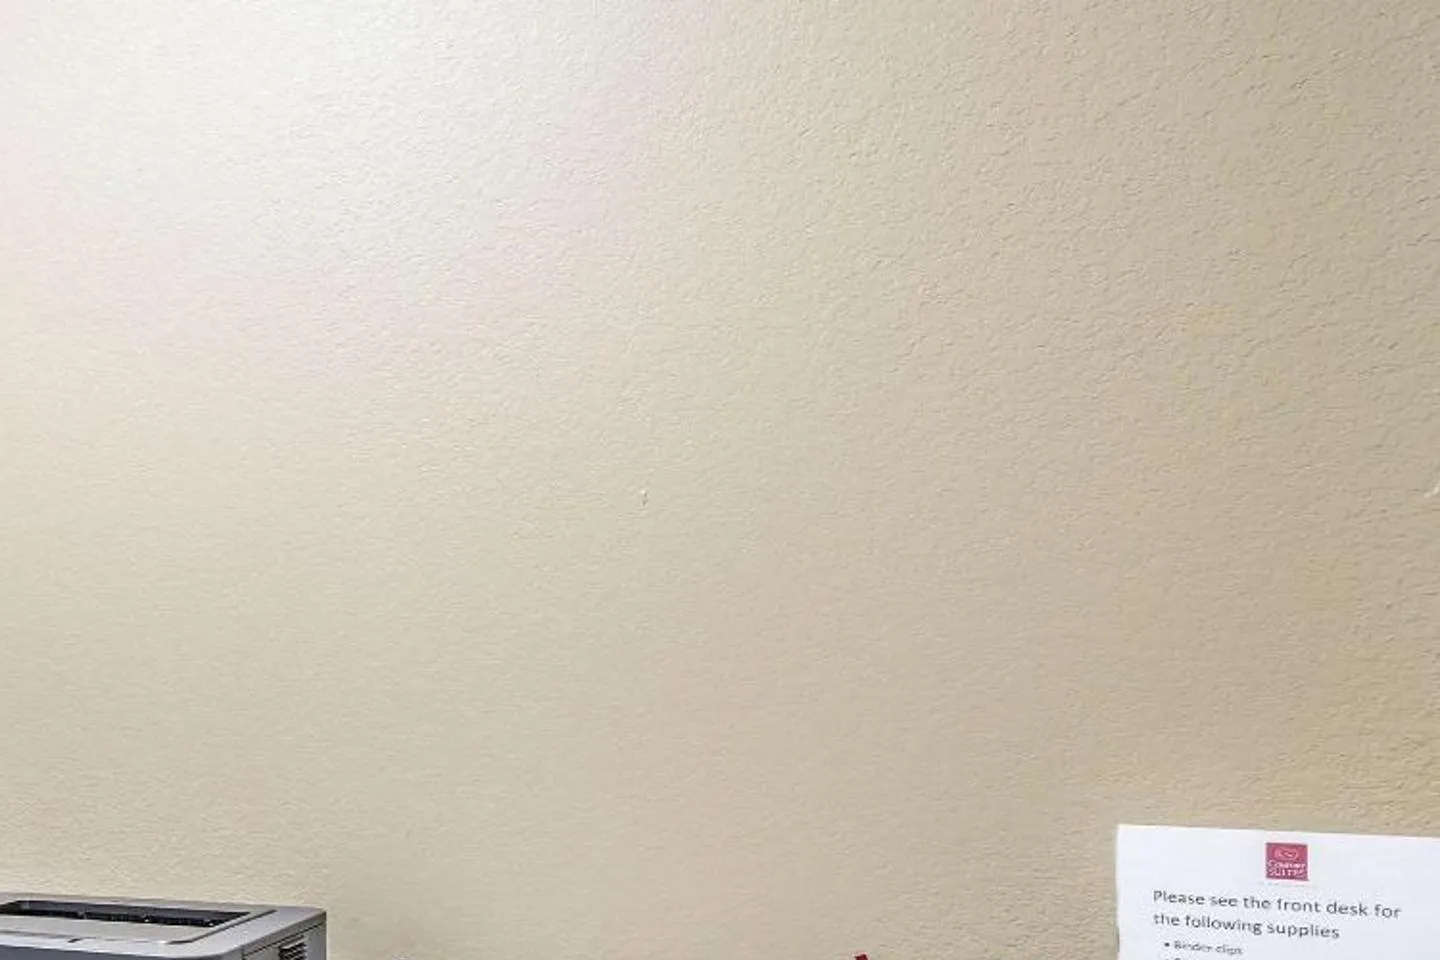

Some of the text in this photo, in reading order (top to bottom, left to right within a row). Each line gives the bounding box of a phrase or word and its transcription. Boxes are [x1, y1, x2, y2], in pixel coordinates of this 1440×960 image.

[1153, 889, 1402, 919] Please see the front desk for
[1153, 913, 1340, 939] the following supplies
[1174, 940, 1243, 956] Binder clips
